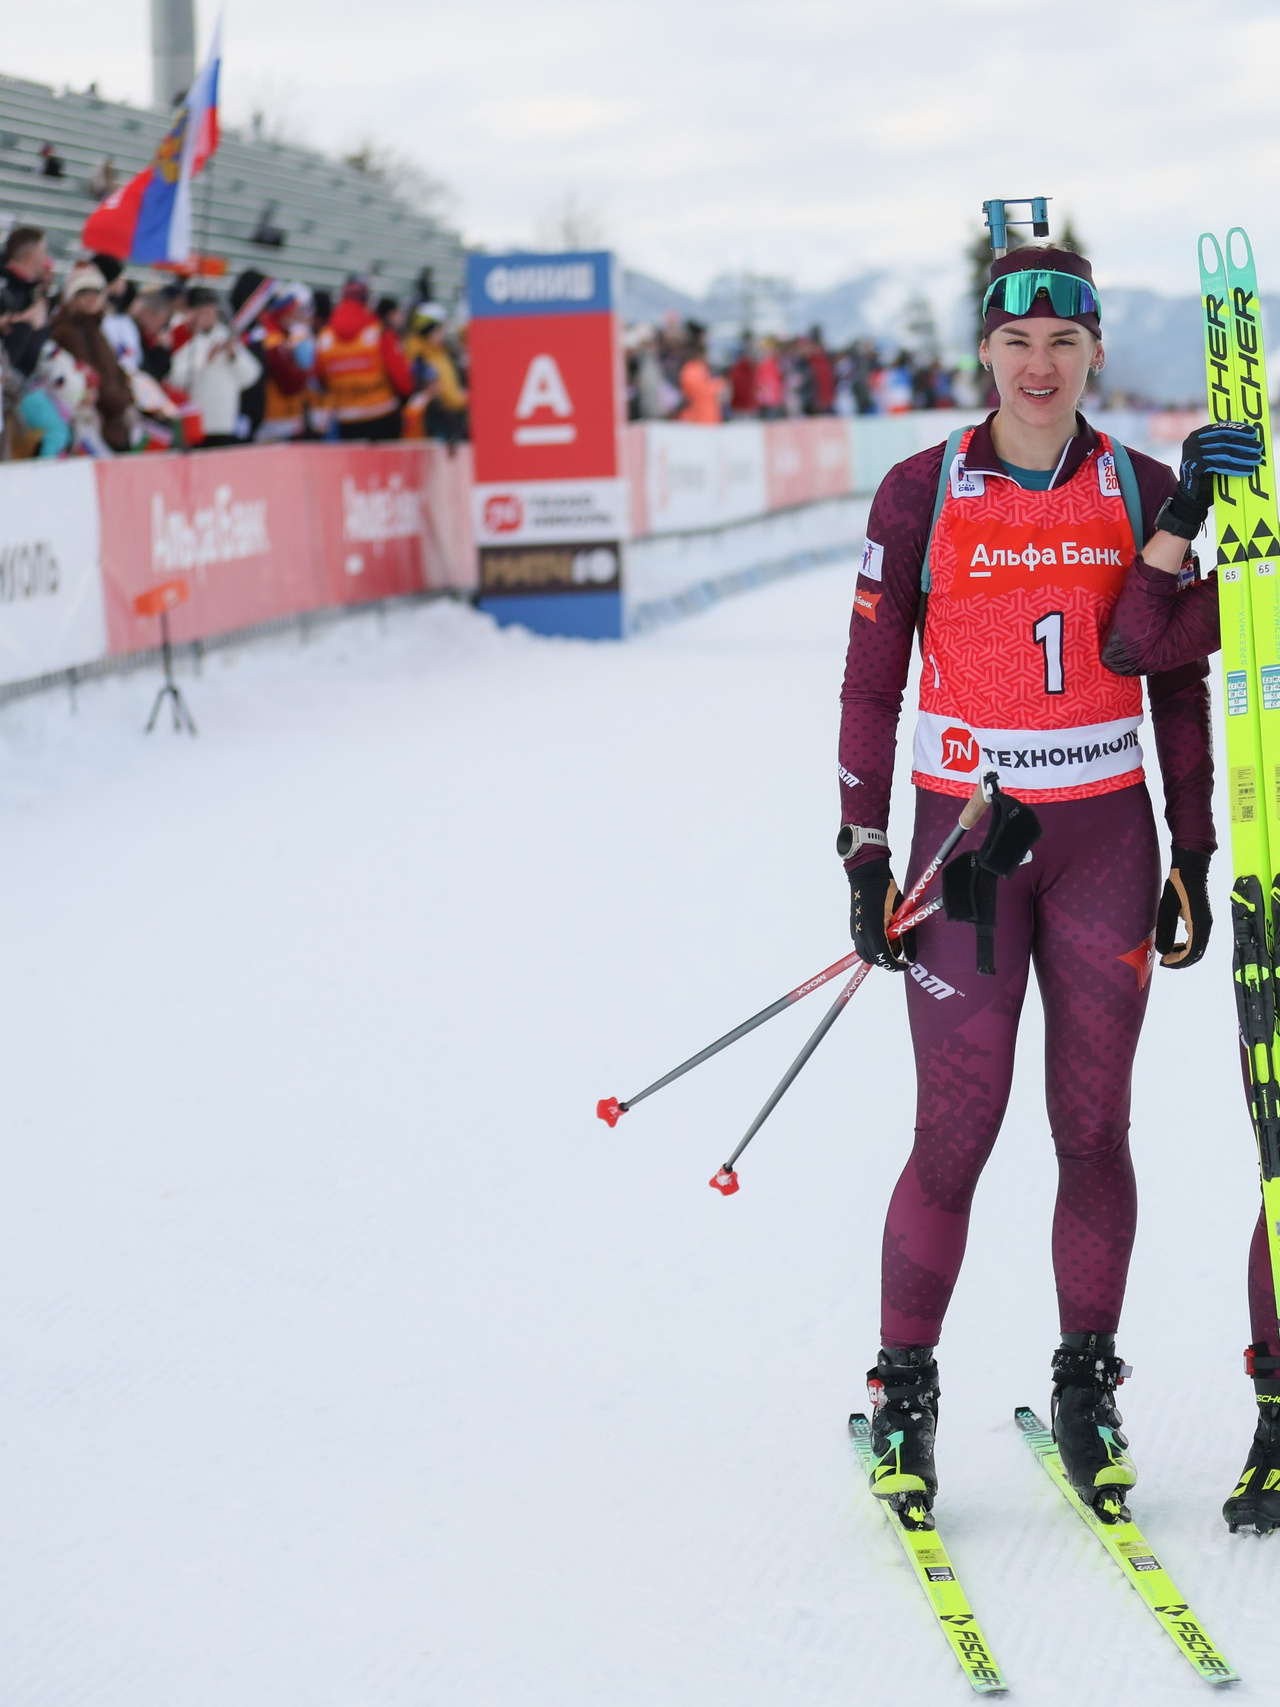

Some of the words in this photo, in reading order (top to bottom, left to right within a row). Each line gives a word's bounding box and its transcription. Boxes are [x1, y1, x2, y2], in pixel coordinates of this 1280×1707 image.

[1207, 293, 1237, 506] FCHER
[970, 543, 1058, 571] Альфа
[1062, 542, 1123, 567] Банк
[1259, 563, 1270, 574] 65
[1225, 570, 1237, 580] 65
[1033, 611, 1065, 694] 1
[908, 857, 943, 904] MOAX
[893, 903, 941, 936] MOAX
[876, 953, 897, 974] MOA
[797, 974, 827, 996] MOAX
[845, 969, 868, 998] MOAX
[954, 1630, 1001, 1688] FISCHER
[1171, 1621, 1230, 1677] FISCHER
